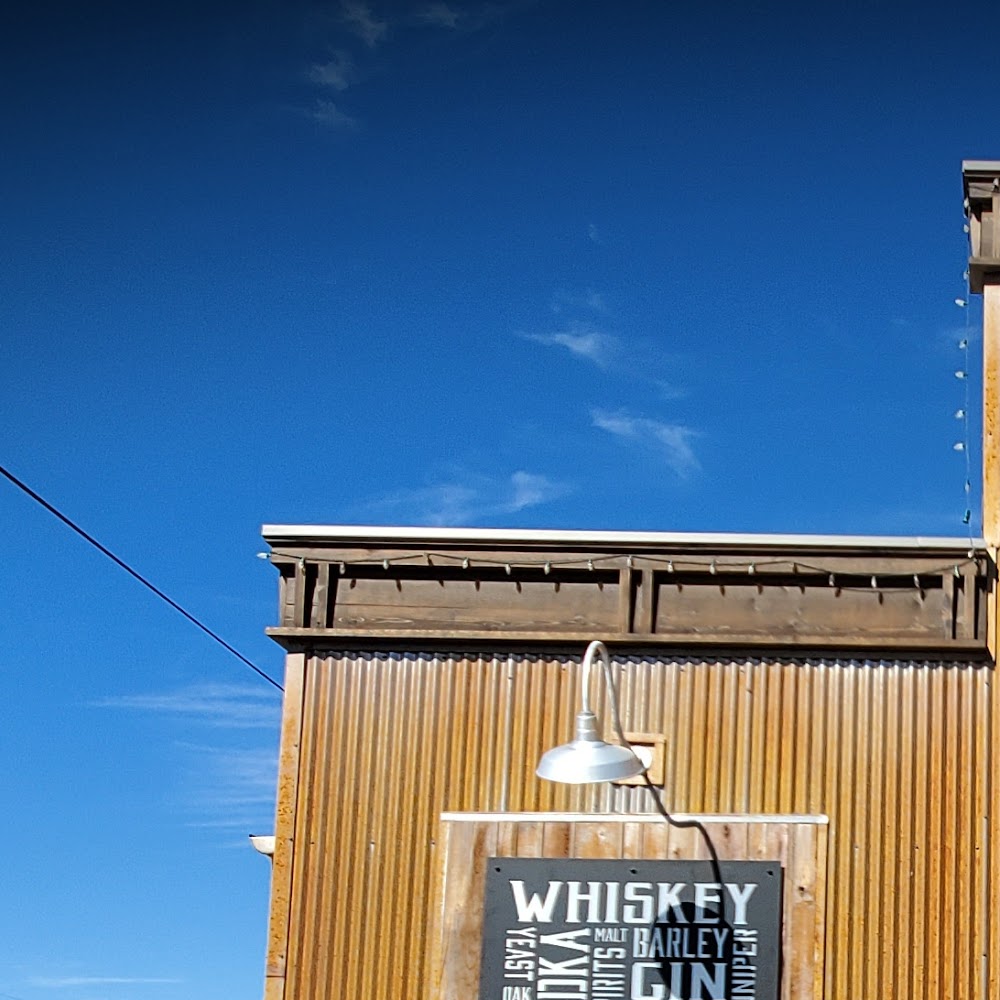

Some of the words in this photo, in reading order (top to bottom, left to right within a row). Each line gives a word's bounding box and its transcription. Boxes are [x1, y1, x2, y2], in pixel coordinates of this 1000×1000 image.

[509, 880, 758, 924] WHISKEY
[503, 927, 538, 981] YEAST
[594, 928, 629, 942] MALT
[632, 927, 729, 958] BARLEY
[630, 962, 727, 1000] GIN
